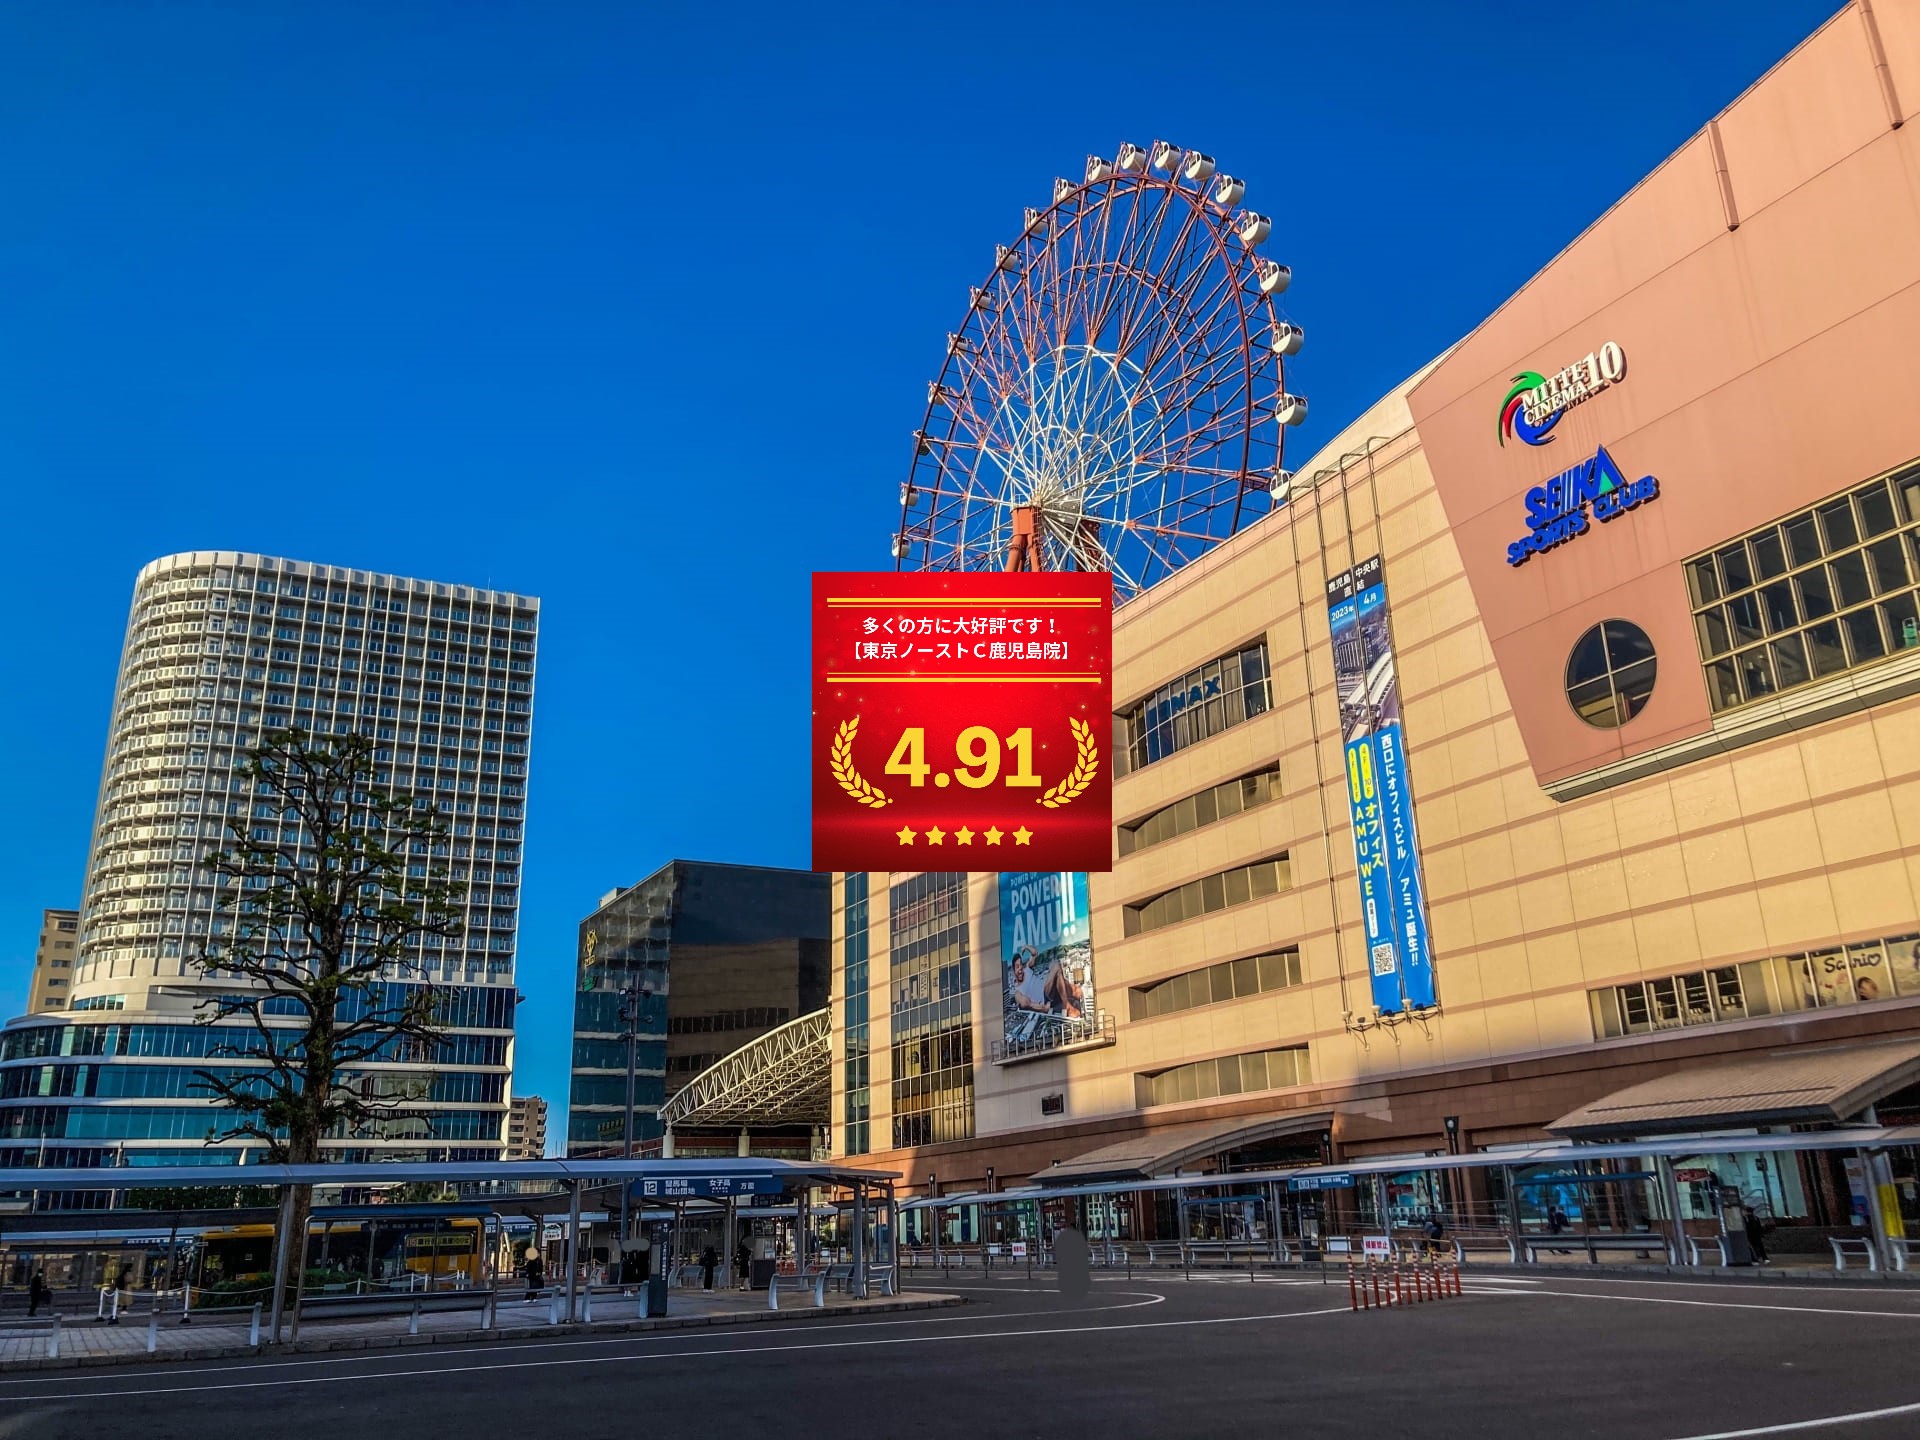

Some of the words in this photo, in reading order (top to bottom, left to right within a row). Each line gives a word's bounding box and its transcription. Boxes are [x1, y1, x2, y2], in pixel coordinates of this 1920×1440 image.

[1522, 360, 1586, 412] MITTE
[1583, 340, 1623, 391] 10
[1524, 381, 1588, 425] CINEMA
[1524, 444, 1625, 529] SEIKA
[1506, 510, 1587, 564] SPORTS
[1592, 475, 1658, 520] CLUB
[1365, 802, 1385, 867] オフィス
[1011, 874, 1061, 914] POWER
[645, 1182, 657, 1194] 12
